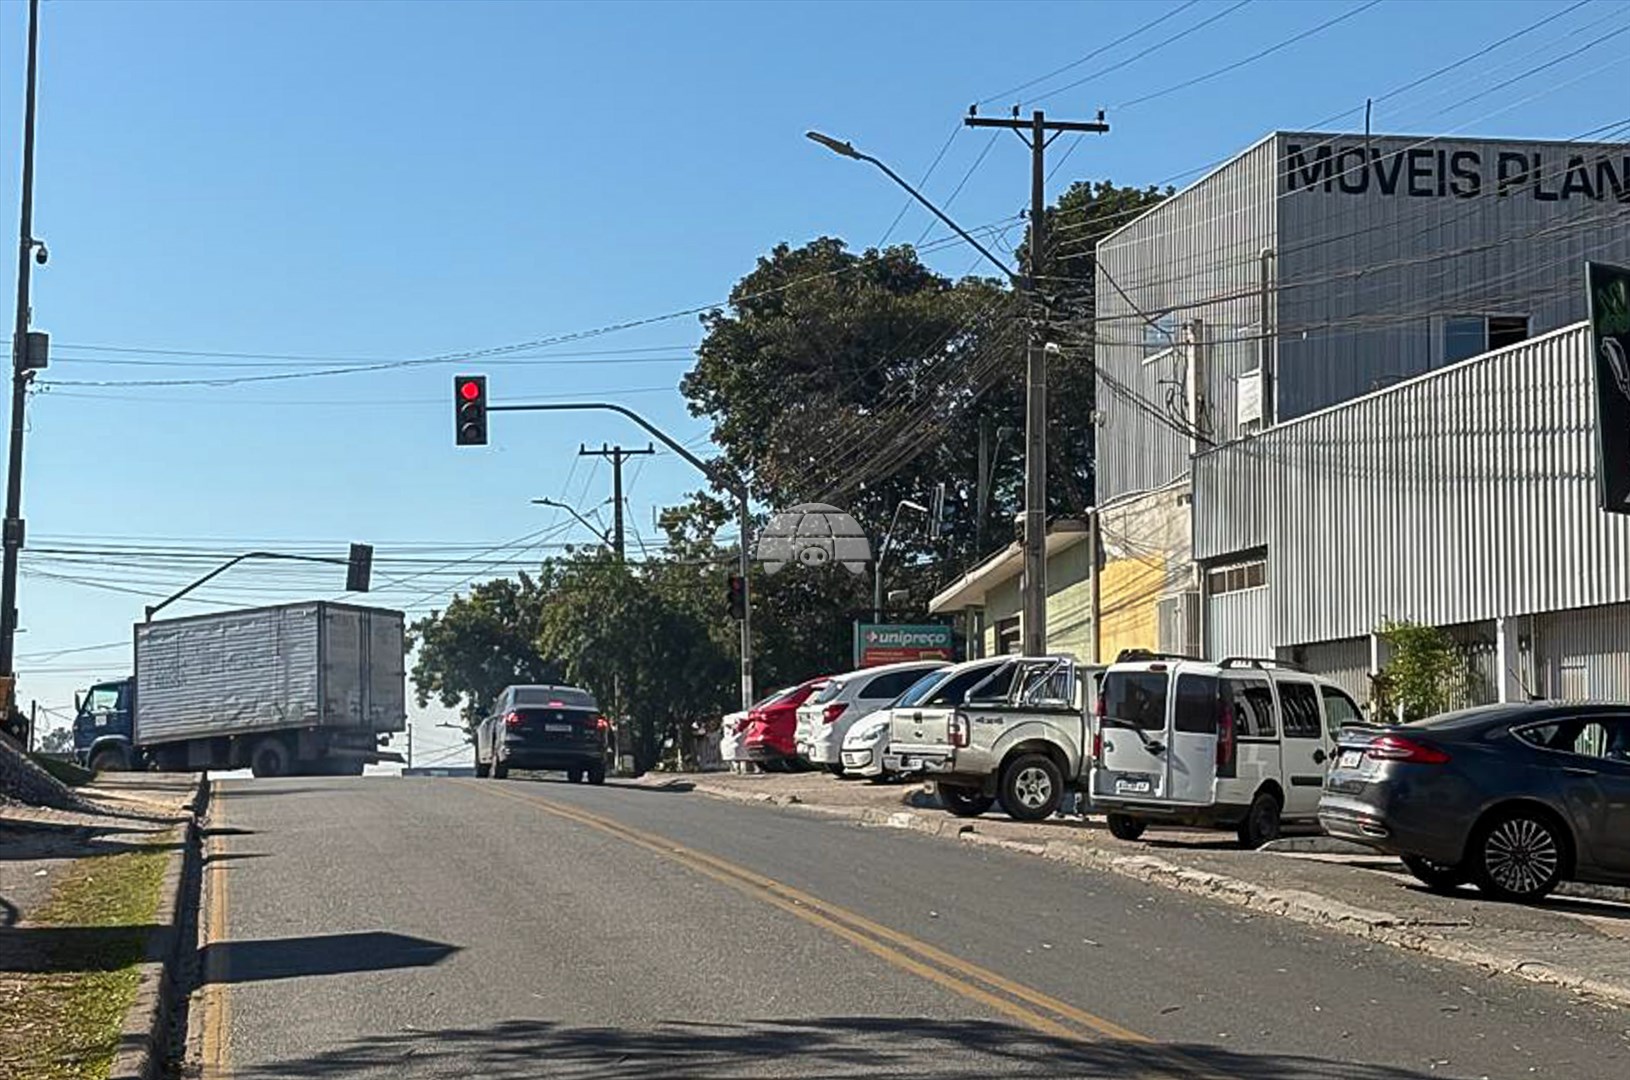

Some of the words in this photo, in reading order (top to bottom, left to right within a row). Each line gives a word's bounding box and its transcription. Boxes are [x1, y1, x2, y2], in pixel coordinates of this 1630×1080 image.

[1287, 144, 1482, 198] MOVEIS
[1497, 152, 1630, 203] PLAN
[879, 629, 947, 647] unipreço
